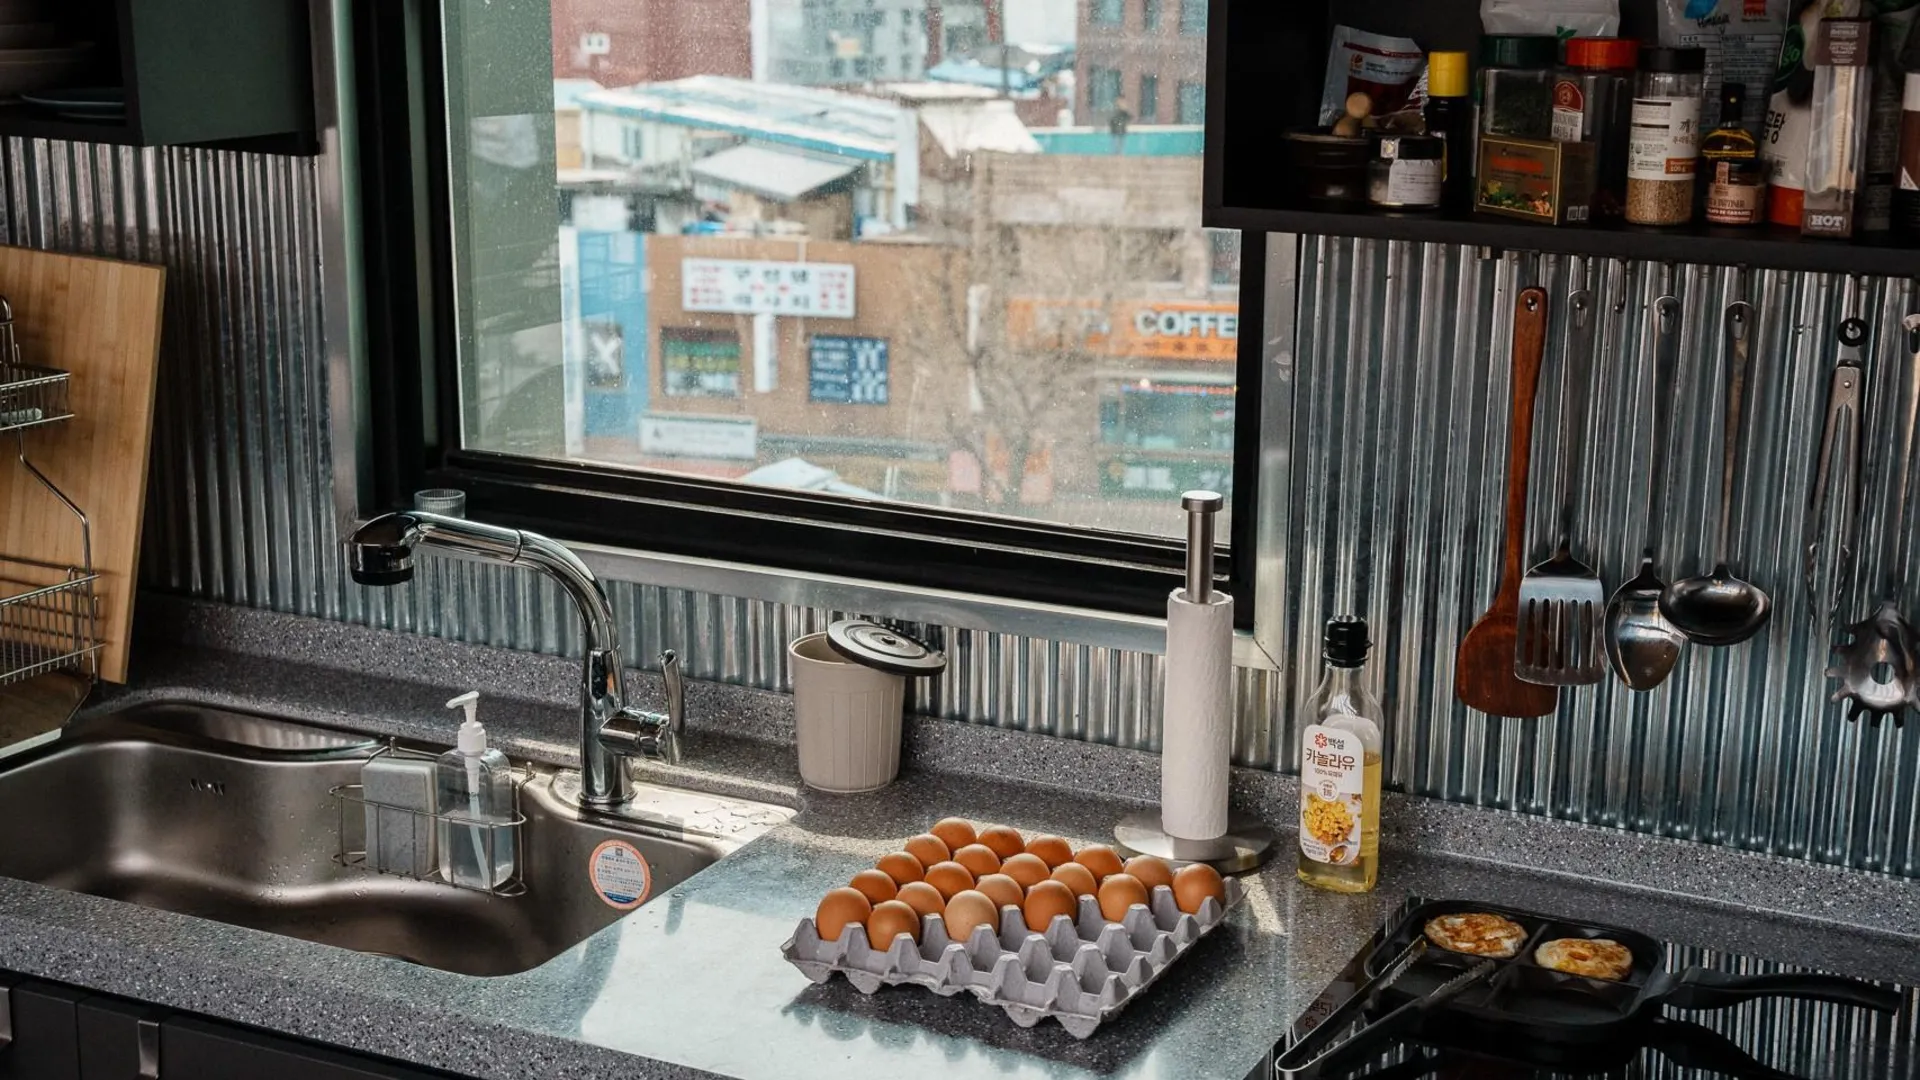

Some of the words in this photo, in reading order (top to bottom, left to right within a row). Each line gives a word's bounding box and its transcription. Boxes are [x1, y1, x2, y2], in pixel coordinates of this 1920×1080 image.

[1810, 214, 1843, 227] HOT
[1328, 737, 1345, 750] 백설
[1306, 747, 1355, 771] 카놀라유
